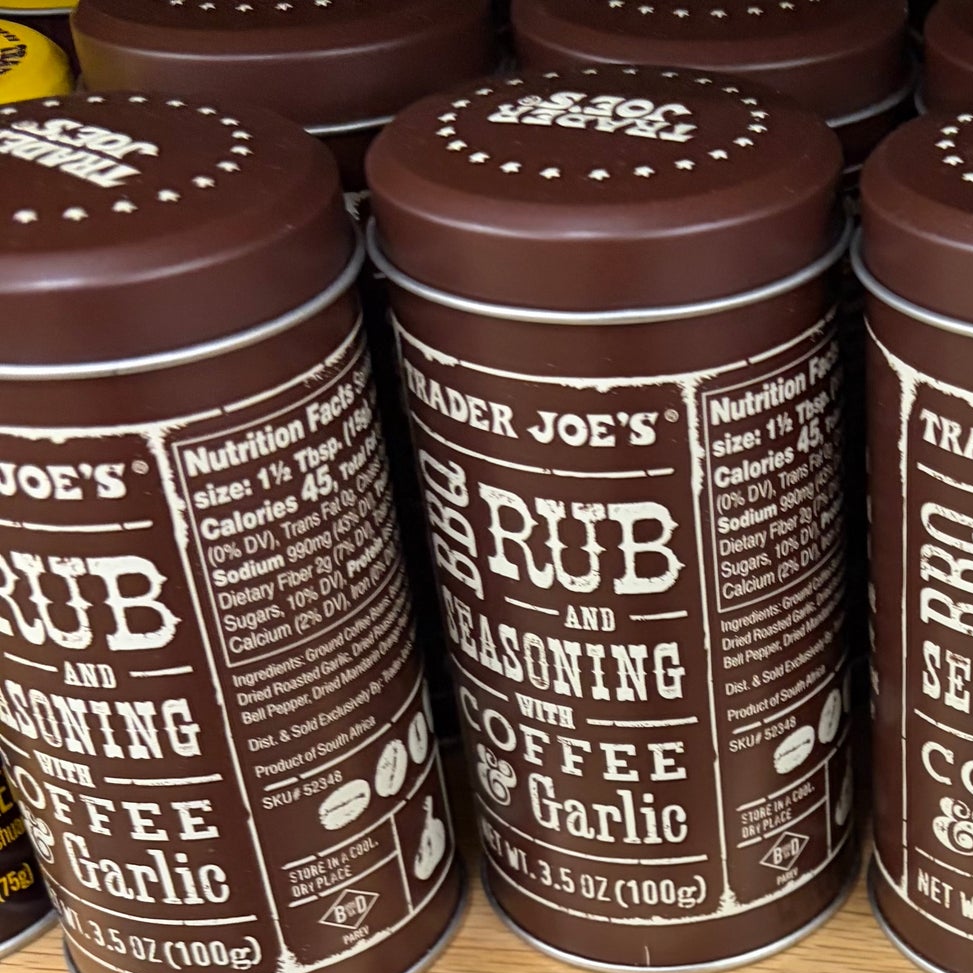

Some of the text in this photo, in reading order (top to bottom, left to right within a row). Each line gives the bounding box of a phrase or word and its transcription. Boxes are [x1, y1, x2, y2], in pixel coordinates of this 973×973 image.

[487, 104, 698, 143] TRADER
[403, 357, 520, 439] TRADER
[526, 409, 660, 448] JOE'S
[710, 372, 807, 425] Nutrition
[182, 419, 306, 478] Nutrition
[305, 382, 355, 433] Facts
[712, 429, 761, 458] size:
[714, 446, 794, 489] Calories
[193, 477, 253, 510] size:
[201, 495, 299, 541] Calories
[418, 448, 485, 601] BBQ
[717, 503, 778, 535] Sodium
[207, 511, 322, 569] (0% Trans
[477, 480, 687, 596] RUB
[719, 530, 767, 557] Dietary
[213, 553, 285, 587] Sodium
[217, 564, 313, 611] Dietary Fiber
[722, 571, 776, 600] Calcium
[563, 604, 617, 632] AND
[228, 623, 293, 654] Calcium
[441, 584, 687, 703] SEASONING
[722, 633, 752, 651] Dried
[63, 660, 118, 689] AND
[232, 655, 305, 688] Ingredients:
[723, 653, 745, 669] Bell
[236, 665, 322, 707] Dried Roasted
[241, 707, 267, 725] Bell
[515, 692, 576, 731] WITH
[727, 698, 769, 722] Product
[248, 717, 319, 752] Dist. & Sold
[458, 685, 688, 783] COFFEE
[33, 749, 97, 789] WITH
[254, 733, 351, 779] Product of South
[262, 788, 302, 811] SKU#
[528, 771, 688, 845] Garlic
[740, 803, 773, 825] STORE
[741, 808, 793, 839] DRY PLACE
[62, 831, 230, 905] Garlic
[288, 855, 341, 884] STORE IN
[291, 864, 353, 898] DRY PLACE
[504, 841, 537, 880] WT.
[538, 859, 576, 895] 3.5
[916, 867, 954, 909] NET
[88, 920, 126, 955] 3.5
